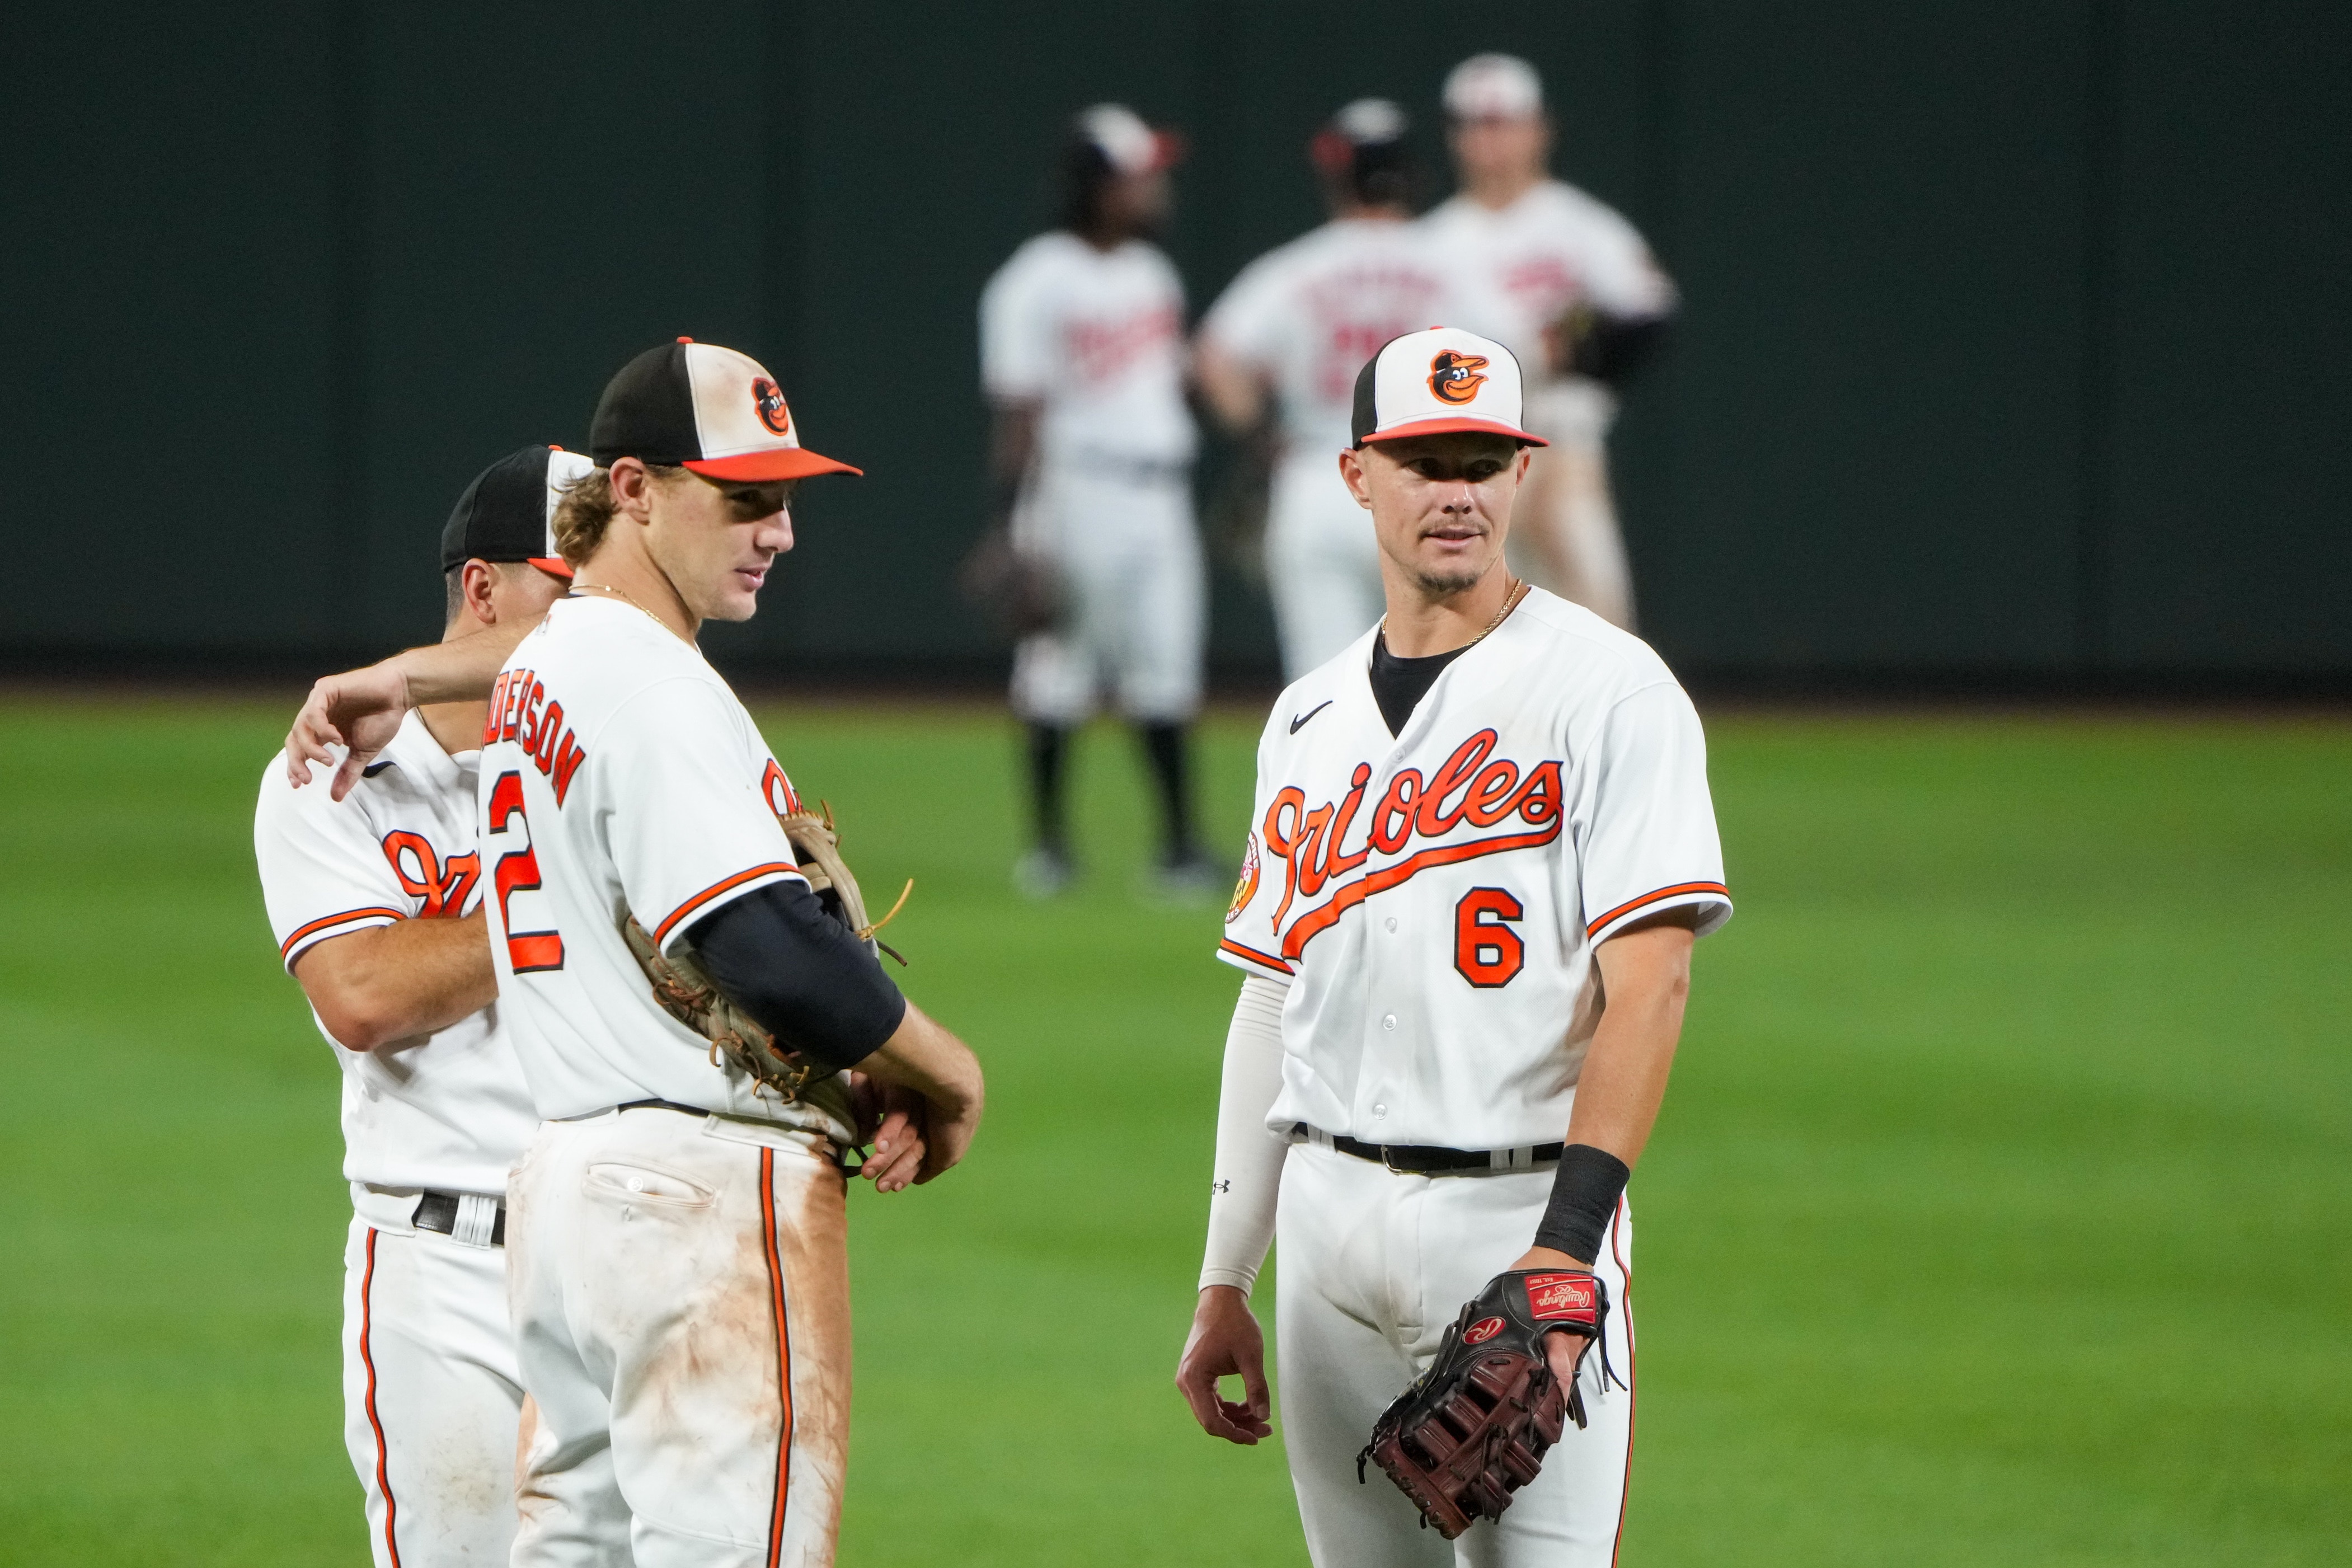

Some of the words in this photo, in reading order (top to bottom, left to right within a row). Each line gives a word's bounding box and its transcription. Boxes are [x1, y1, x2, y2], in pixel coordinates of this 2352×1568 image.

[482, 668, 586, 811] DERSON
[382, 829, 485, 919] Or
[489, 769, 565, 975] 2
[1262, 727, 1563, 936] Orioles
[1454, 886, 1524, 988] 6
[1537, 1290, 1590, 1308] Rawlings
